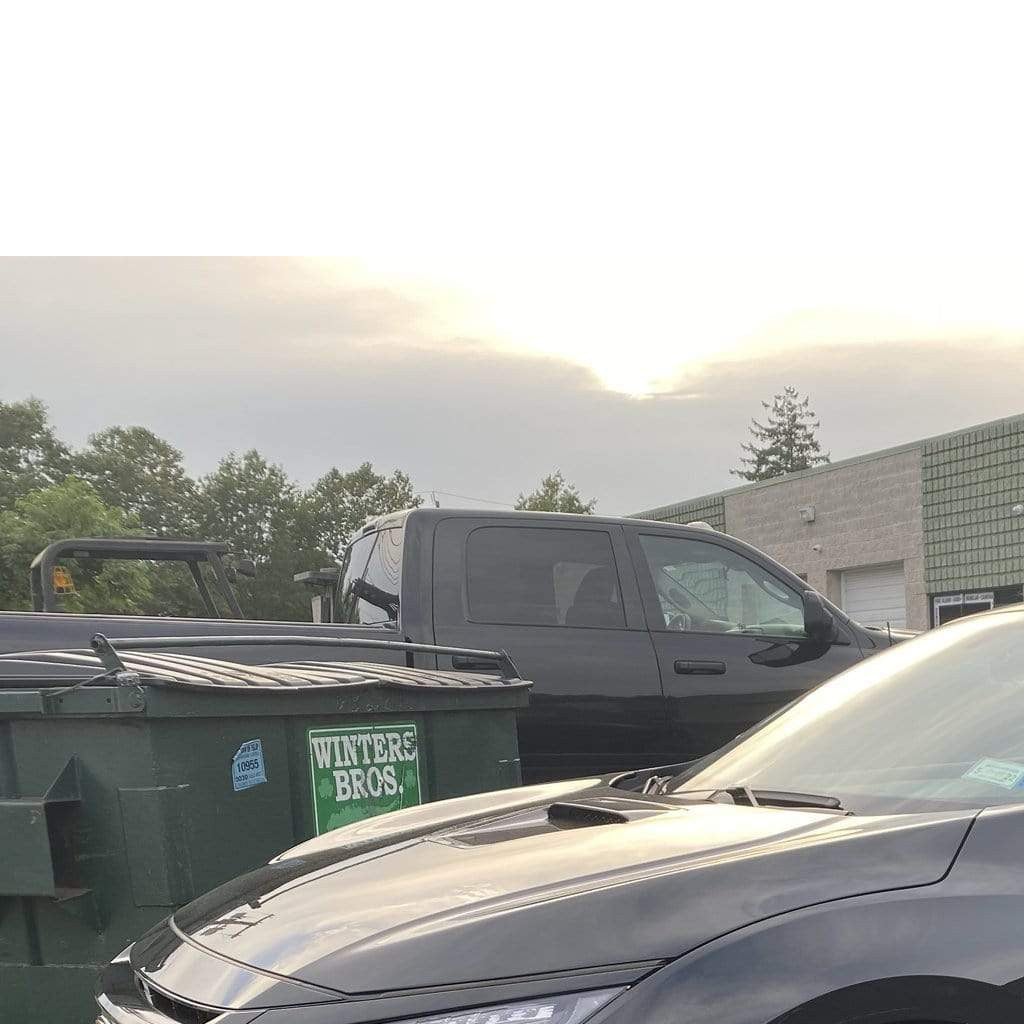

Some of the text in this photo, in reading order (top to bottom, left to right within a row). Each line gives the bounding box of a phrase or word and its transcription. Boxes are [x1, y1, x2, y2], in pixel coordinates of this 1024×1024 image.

[237, 759, 260, 773] 10955
[311, 731, 417, 769] WINTERS
[333, 765, 404, 802] BROS.
